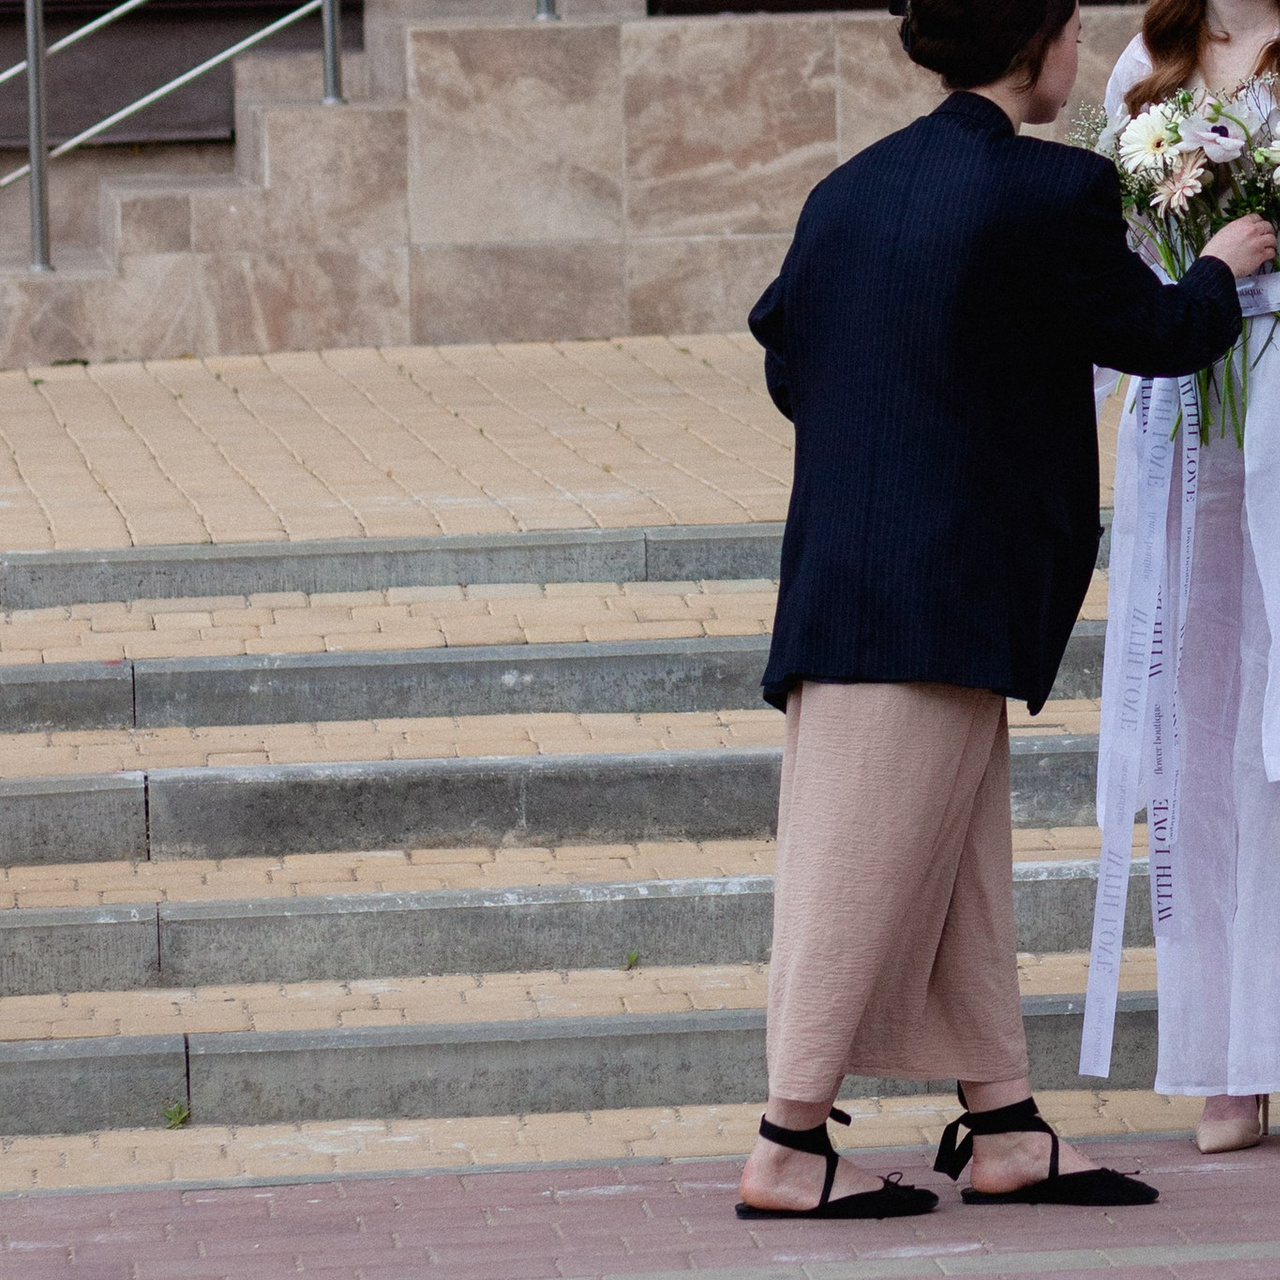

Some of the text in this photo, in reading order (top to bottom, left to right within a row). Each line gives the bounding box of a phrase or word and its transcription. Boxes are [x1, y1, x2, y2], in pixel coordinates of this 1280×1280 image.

[1180, 380, 1199, 503] WITH LOVE
[1153, 703, 1165, 775] flower boutique
[1152, 798, 1173, 922] WITH LOVE
